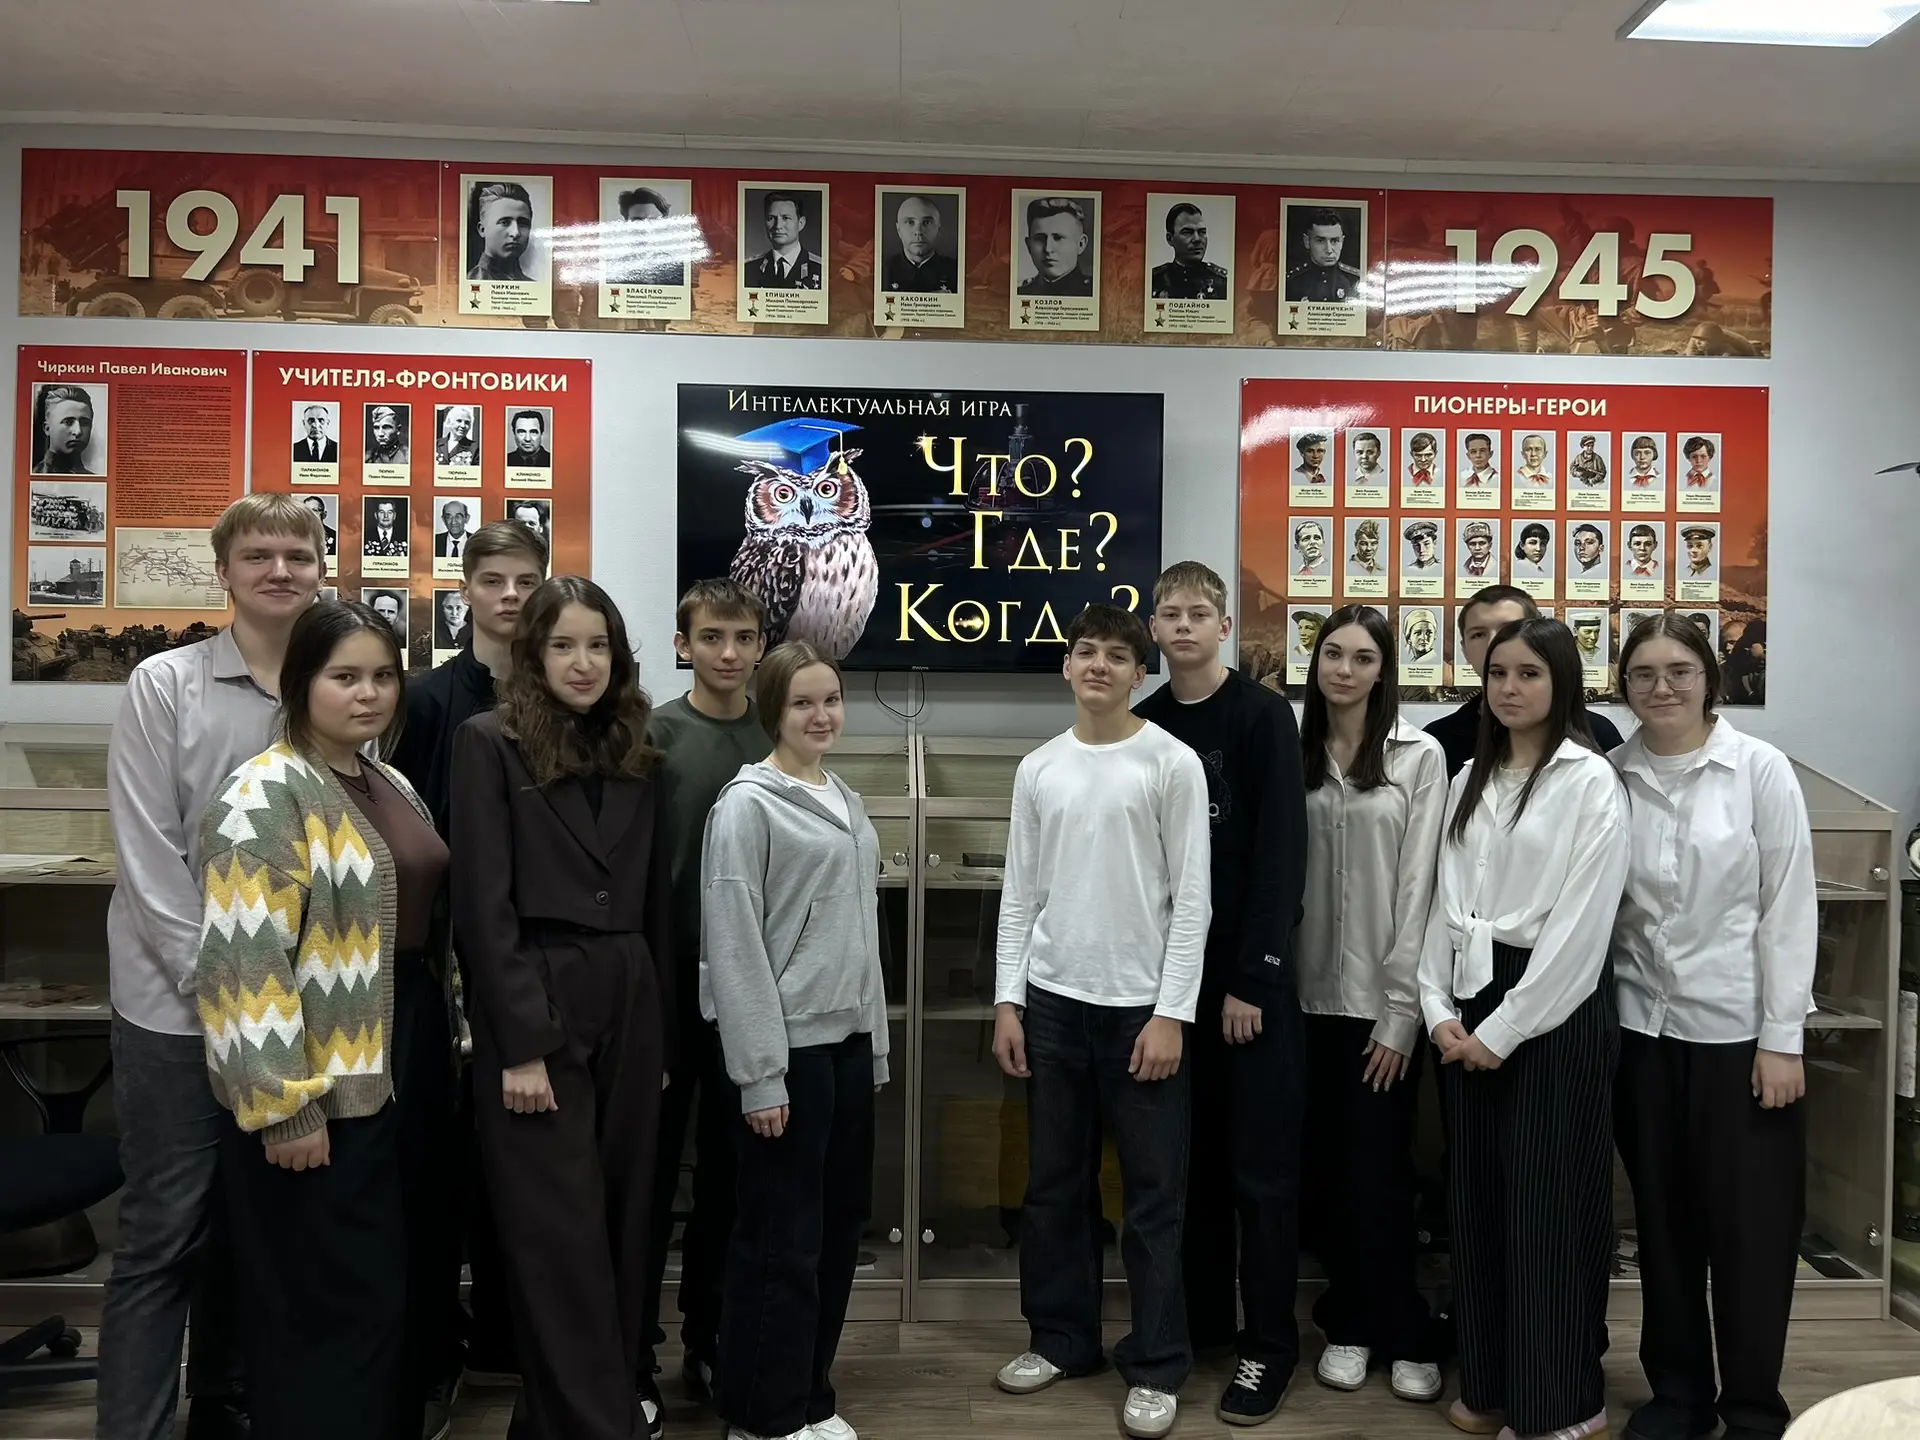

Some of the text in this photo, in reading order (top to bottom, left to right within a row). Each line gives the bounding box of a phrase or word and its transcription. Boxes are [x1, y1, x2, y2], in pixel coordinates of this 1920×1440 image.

[116, 189, 360, 285] 1941
[1445, 228, 1697, 320] 1945
[37, 360, 227, 377] Чиркин Павел Иванович
[278, 367, 568, 392] УЧИТЕЛЯ-ФРОНТОВИКИ
[1414, 395, 1607, 417] ПИОНЕРЫ-ГЕРОИ
